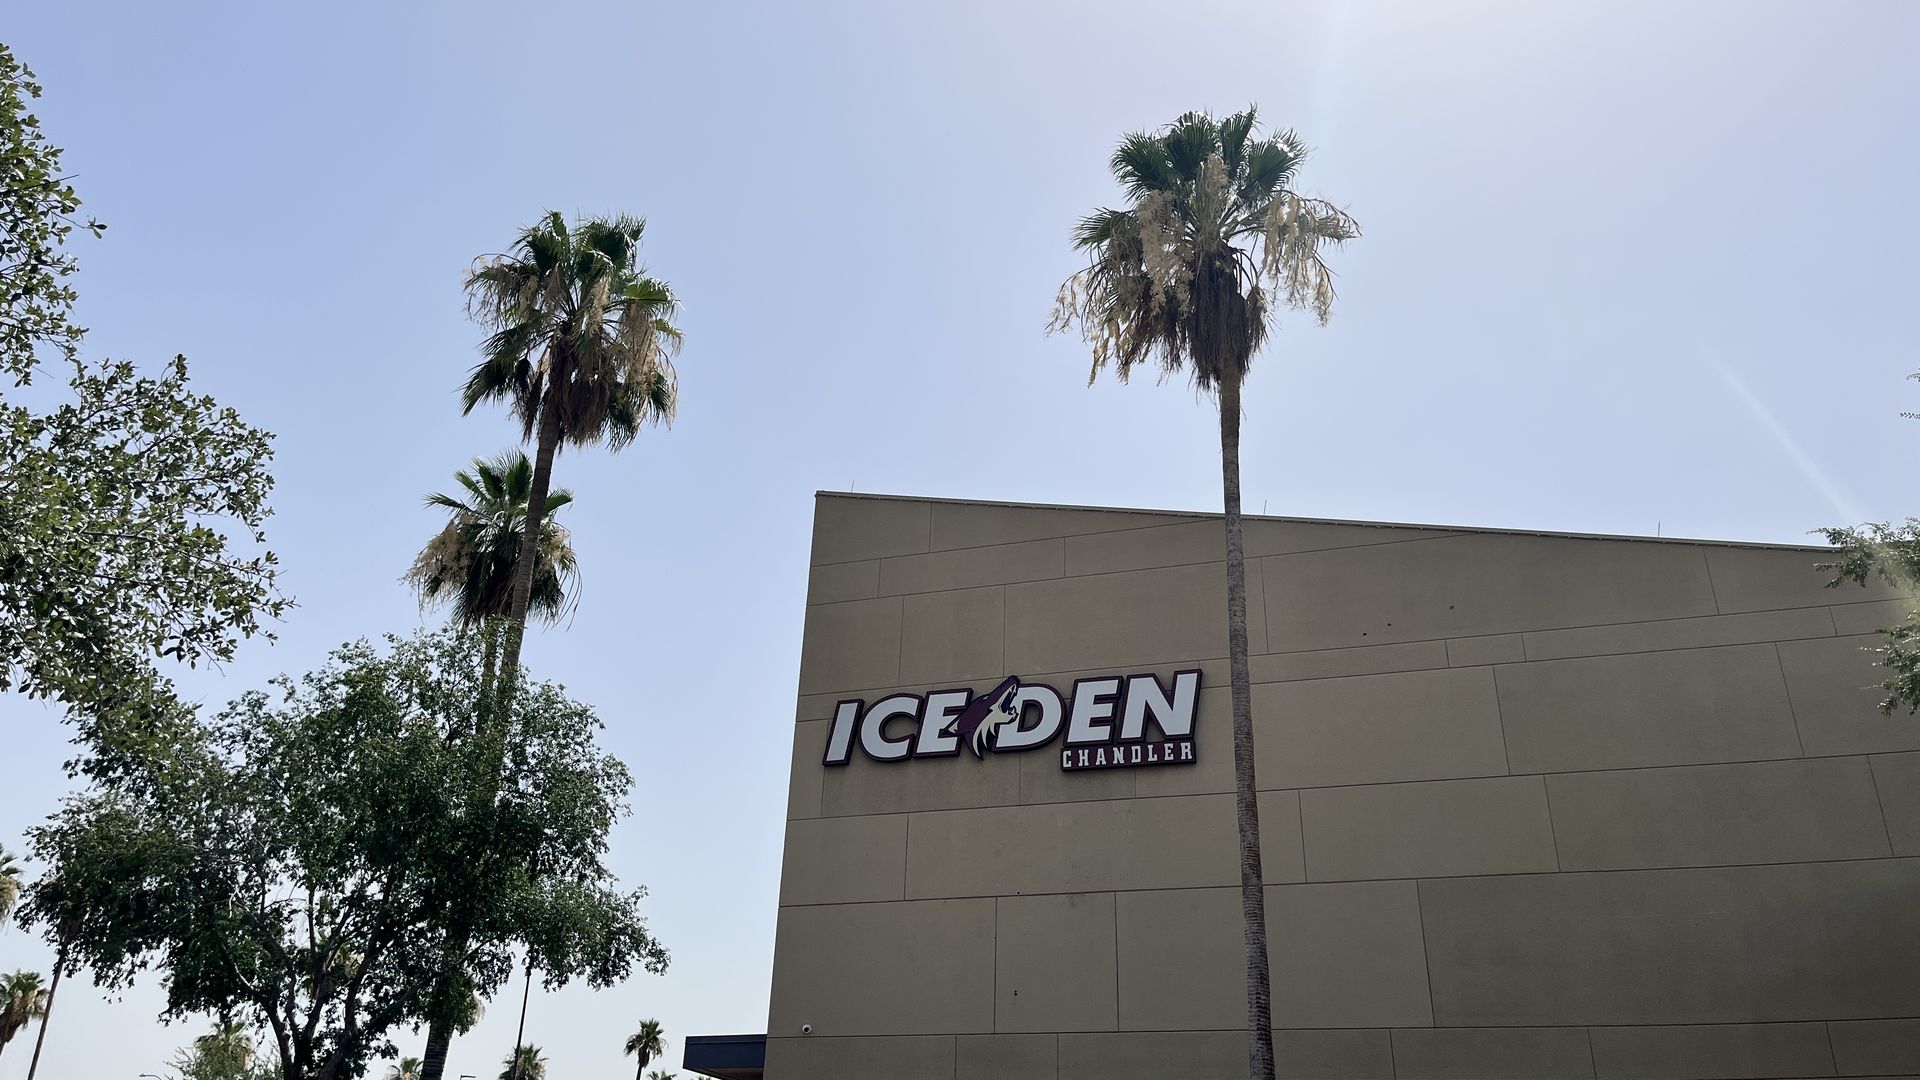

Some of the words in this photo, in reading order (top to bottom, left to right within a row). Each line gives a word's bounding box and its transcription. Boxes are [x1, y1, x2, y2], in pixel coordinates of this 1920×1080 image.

[824, 689, 972, 764] ICE
[994, 671, 1200, 749] DEN
[1062, 742, 1193, 768] CHANDLER
